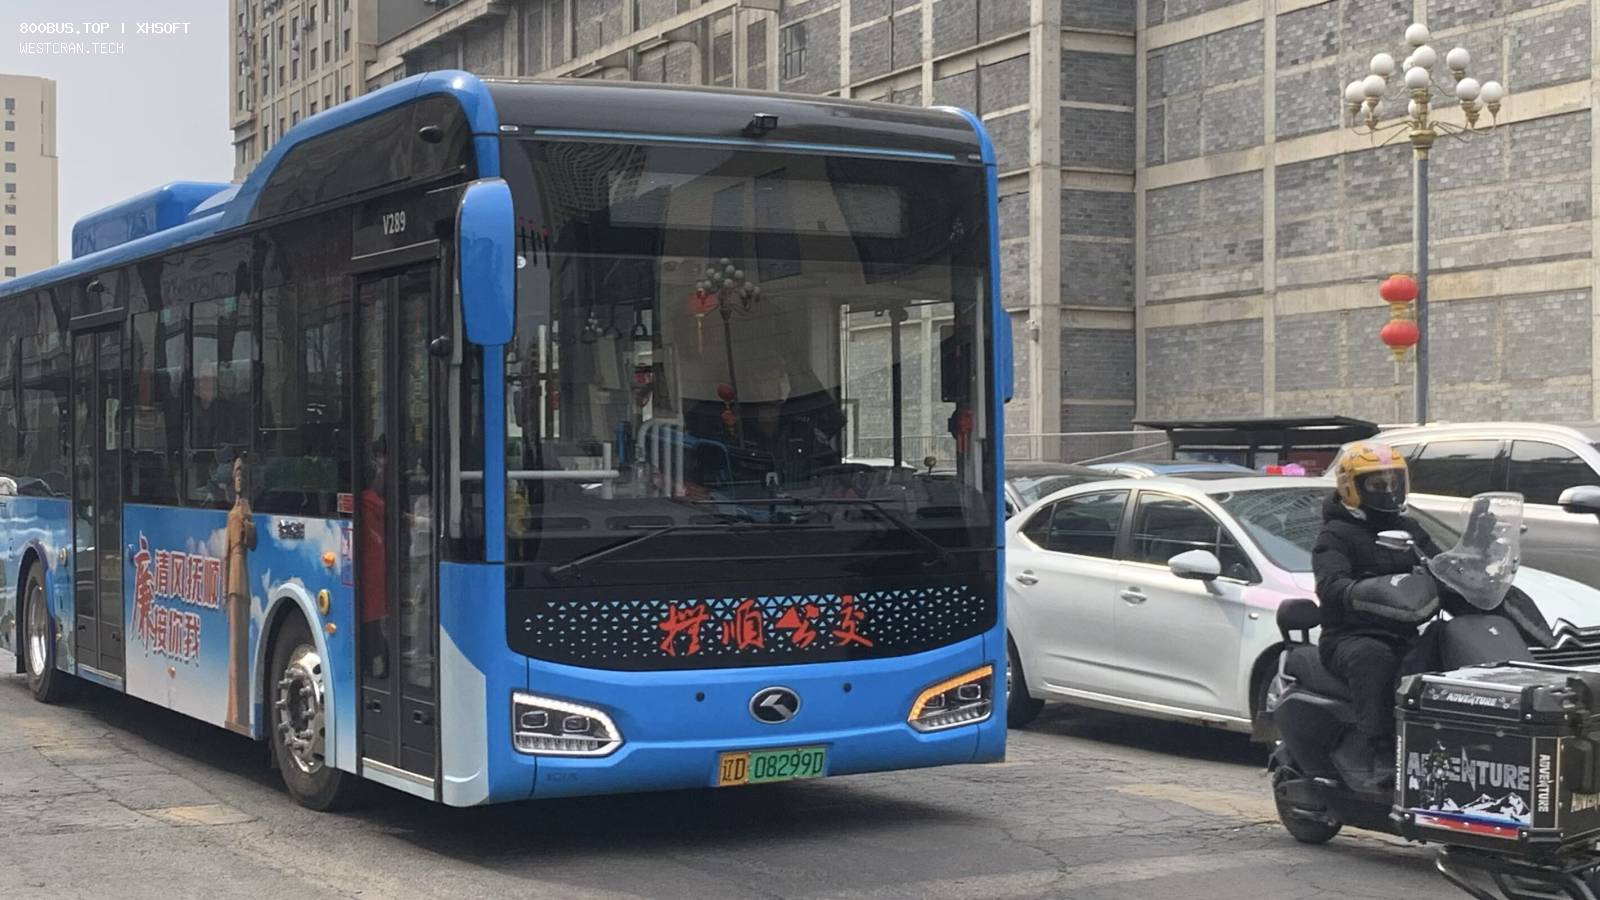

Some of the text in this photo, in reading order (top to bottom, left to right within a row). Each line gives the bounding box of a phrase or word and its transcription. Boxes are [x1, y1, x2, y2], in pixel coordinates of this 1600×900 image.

[382, 210, 406, 235] V289
[154, 550, 220, 608] 清风抚顺
[1446, 692, 1498, 706] ADVENTURE
[722, 752, 824, 781] 辽D 08299D
[1537, 753, 1556, 813] ADVENTURE
